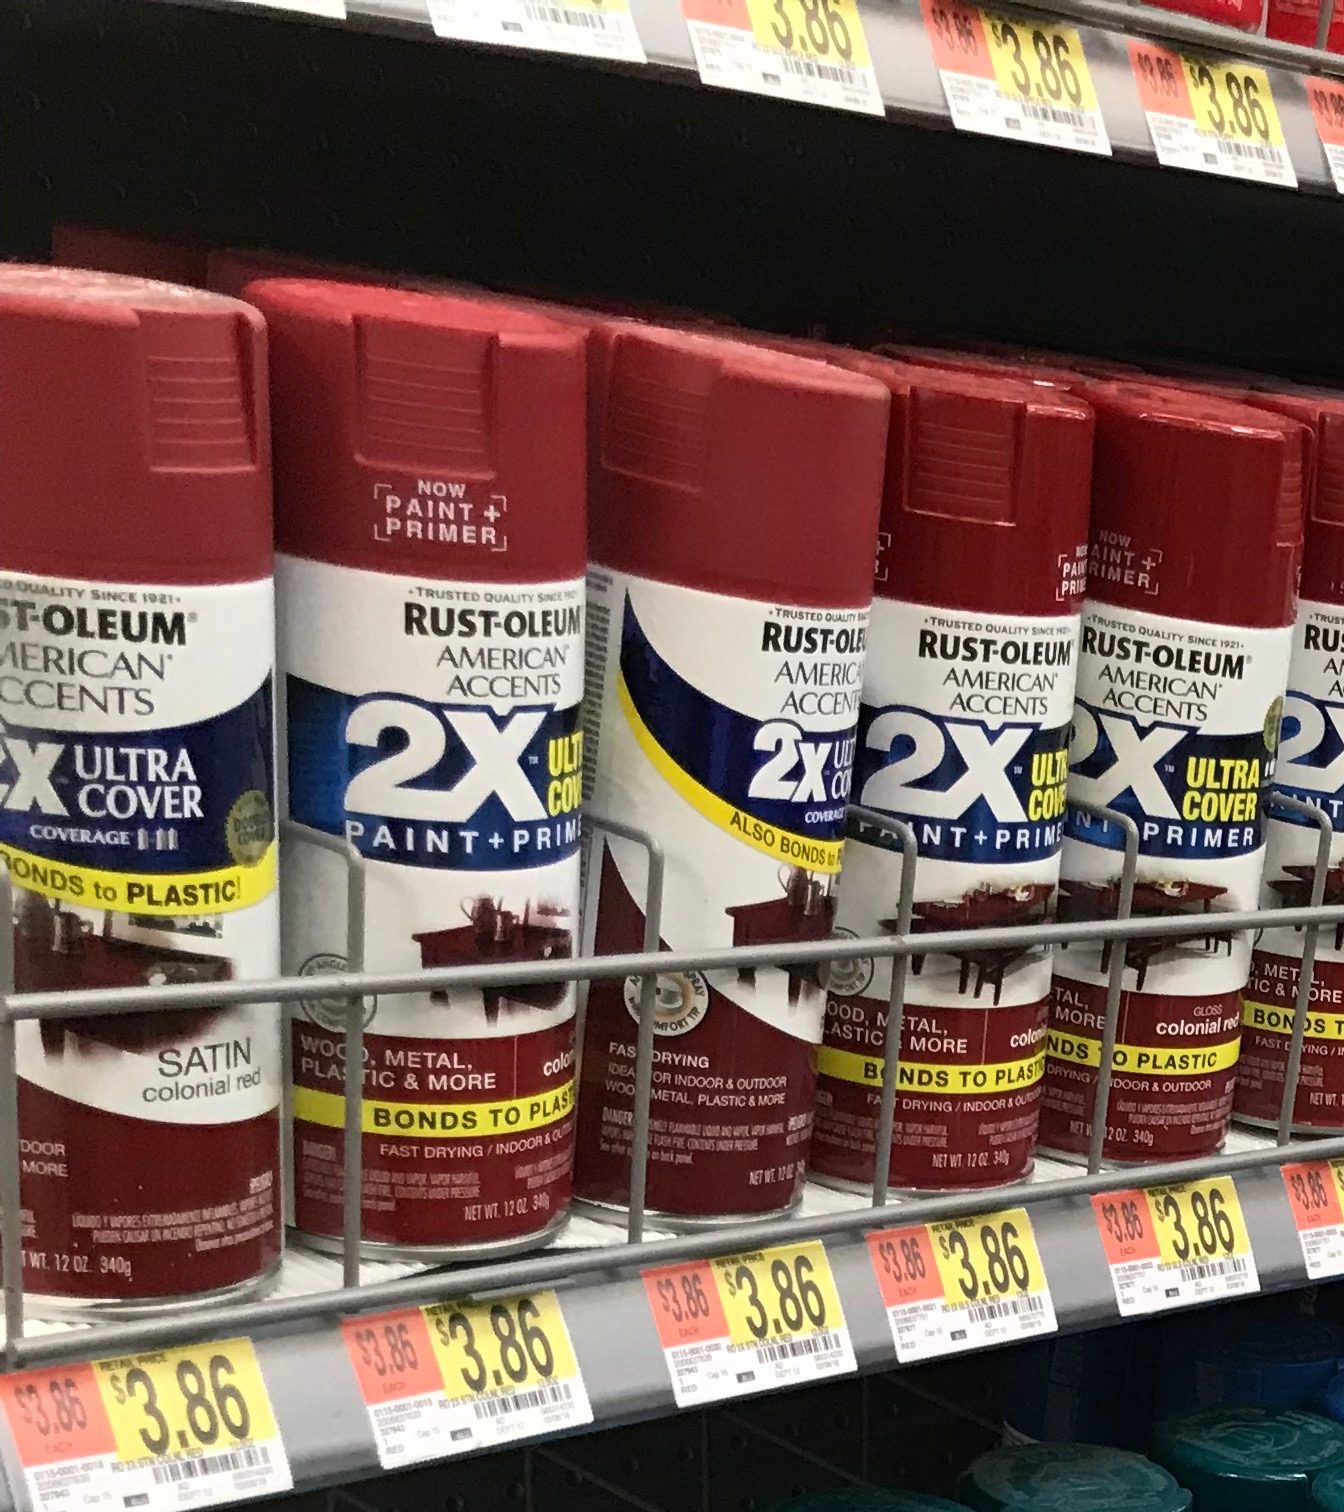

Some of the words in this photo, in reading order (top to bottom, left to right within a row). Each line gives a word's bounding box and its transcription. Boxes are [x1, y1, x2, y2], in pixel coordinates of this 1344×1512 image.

[990, 18, 1083, 104] $3.86
[1187, 62, 1271, 145] $3.86
[417, 480, 467, 498] NOW
[385, 496, 473, 523] PAINT
[385, 518, 497, 545] PRIMER
[437, 645, 568, 670] AMERICAN
[918, 629, 1072, 667] RUST-OLEUM
[446, 675, 562, 697] ACCENTS
[943, 668, 1055, 692] AMERICAN
[1098, 664, 1218, 701] AMERICAN
[949, 694, 1049, 716] ACCENTS
[1102, 686, 1209, 722] ACCENTS
[74, 745, 197, 784] ULTRA
[343, 701, 552, 823] 2X
[749, 723, 830, 804] 2X
[861, 711, 1034, 823] 2X
[1186, 756, 1260, 790] ULTRA
[77, 783, 205, 821] COVER
[1182, 790, 1258, 823] COVER
[30, 823, 131, 848] COVERAGE
[730, 811, 777, 844] ALSO
[93, 876, 118, 904] to
[126, 877, 242, 908] PLASTIC!
[1156, 1016, 1218, 1037] colonial
[1193, 1005, 1223, 1018] GLOSS
[157, 1037, 253, 1079] SATIN
[385, 1048, 474, 1071] METAL,
[652, 1051, 710, 1068] DRYING
[909, 1036, 969, 1055] MORE
[1136, 1051, 1218, 1072] PLASTIC
[142, 1077, 218, 1104] colonial
[223, 1069, 261, 1094] red
[428, 1071, 497, 1092] MORE
[739, 1075, 787, 1090] OUTDOOR
[1166, 1079, 1212, 1093] OUTDOOR
[373, 1105, 478, 1130] BONDS
[489, 1106, 521, 1127] TO
[380, 1144, 420, 1158] FAST
[424, 1144, 483, 1159] DRYING
[1156, 1189, 1236, 1260] $3.86
[939, 1222, 1030, 1301] $3.86
[724, 1255, 827, 1339] $3.86
[440, 1298, 557, 1395] $3.86
[109, 1354, 253, 1456] $3.86
